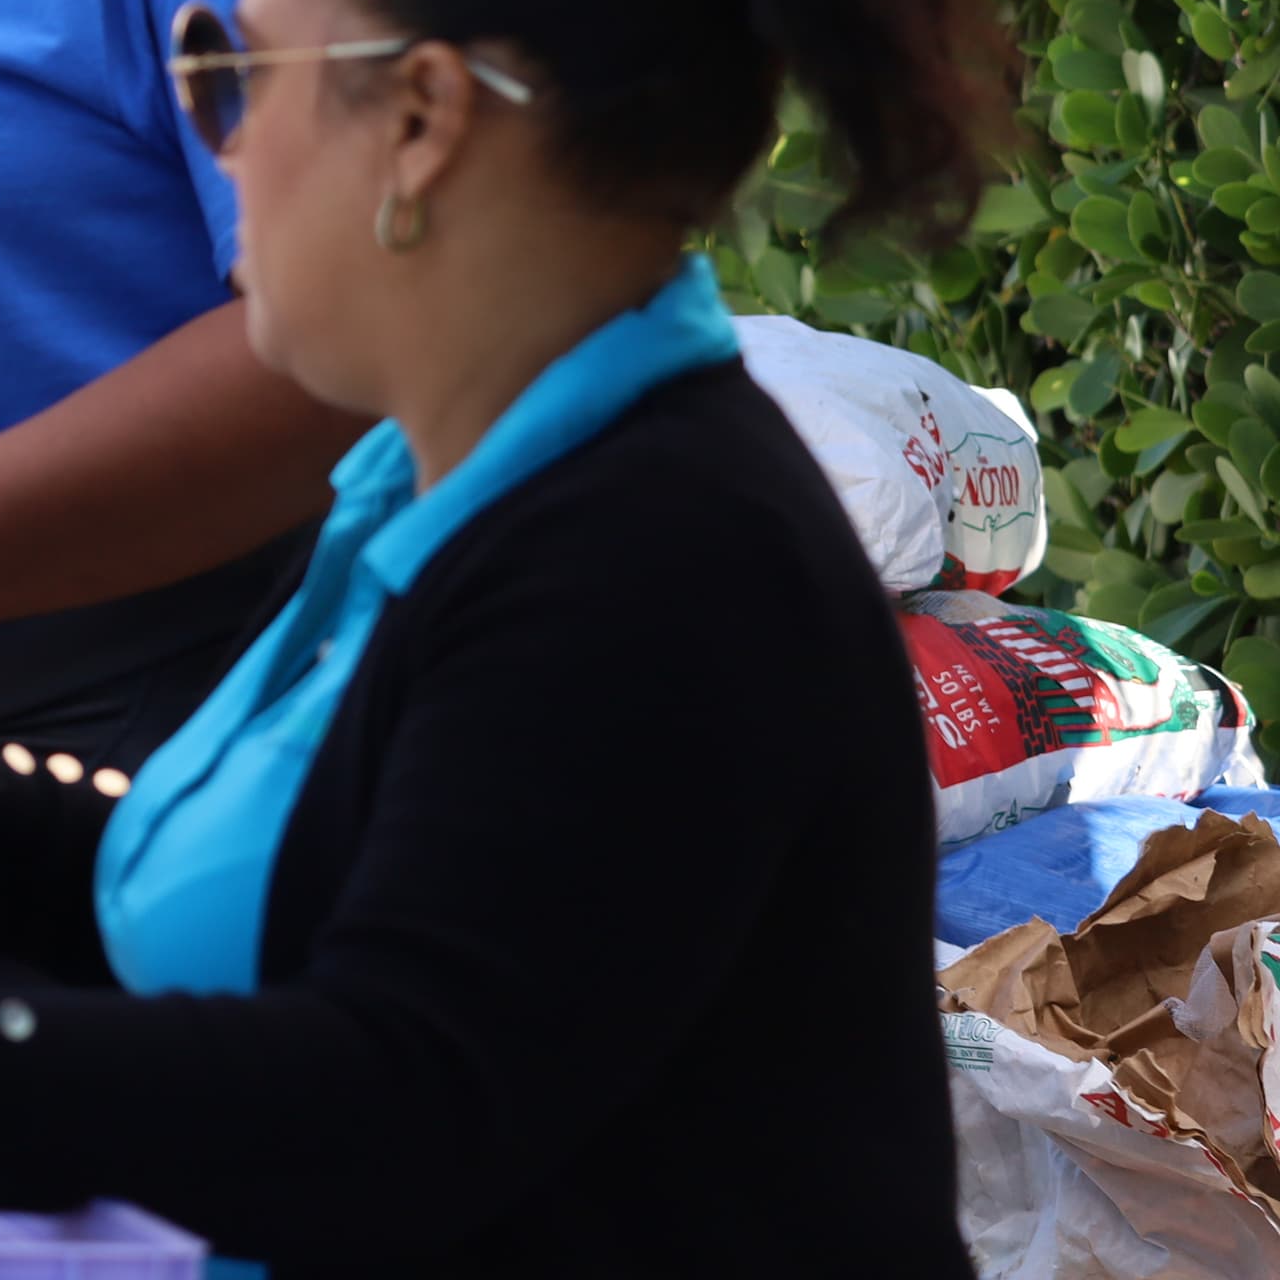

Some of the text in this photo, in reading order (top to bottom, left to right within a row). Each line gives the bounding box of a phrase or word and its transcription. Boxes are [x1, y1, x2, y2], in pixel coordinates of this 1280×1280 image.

[931, 671, 982, 740] 50 LBS.
[952, 664, 1001, 734] NET WT.
